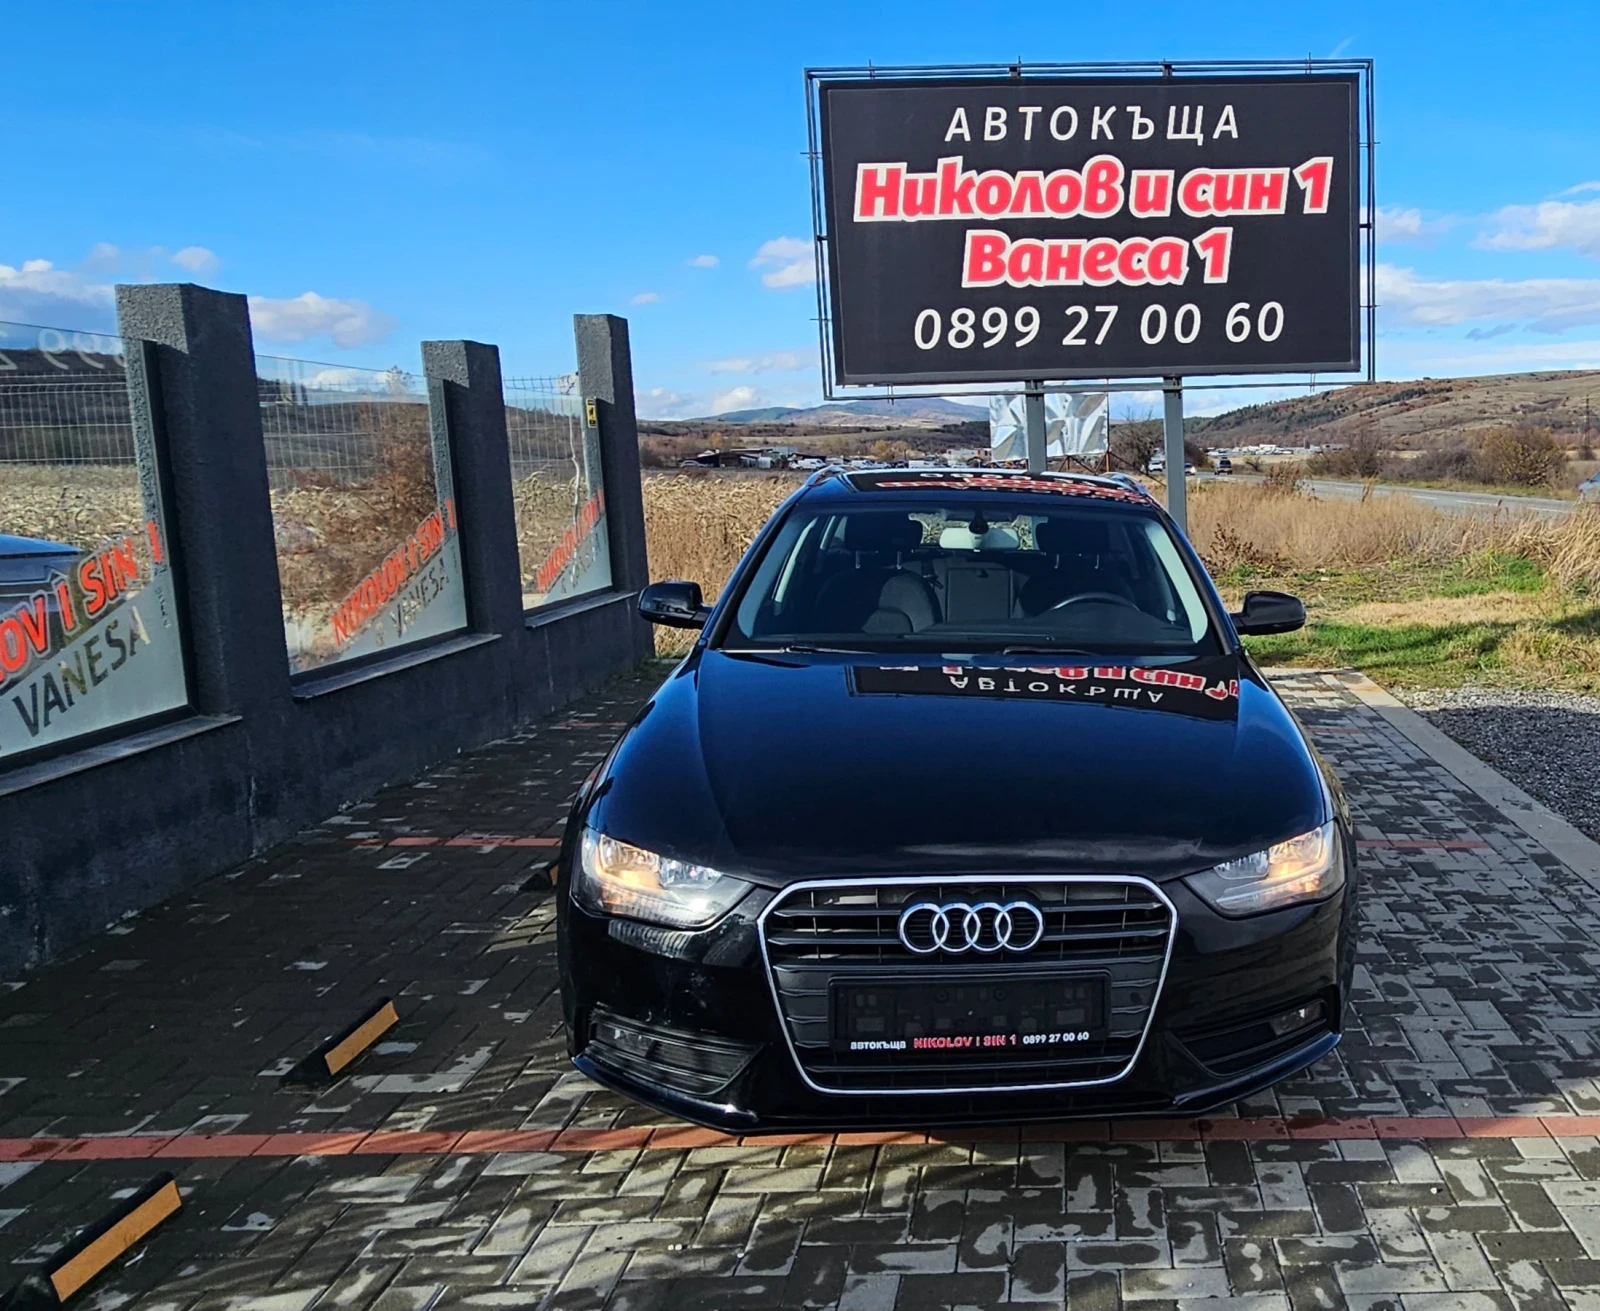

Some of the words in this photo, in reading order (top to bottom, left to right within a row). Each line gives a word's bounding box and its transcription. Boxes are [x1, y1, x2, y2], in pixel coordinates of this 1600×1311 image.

[944, 105, 1239, 145] АВТОКЪЩА
[853, 154, 1124, 222] Николов
[1129, 169, 1174, 218] и
[1178, 167, 1290, 217] син
[1293, 156, 1334, 214] 1
[961, 229, 1190, 288] Ванеса
[1193, 226, 1233, 284] 1
[914, 304, 1041, 350] 0899
[1061, 304, 1119, 346] 27
[1139, 303, 1202, 345] 00
[1225, 301, 1285, 343] 60
[331, 547, 406, 647] NIKOLOV
[418, 510, 444, 560] SIN
[0, 597, 47, 686] OV
[80, 538, 139, 614] SIN
[11, 605, 151, 738] VANESA
[850, 1040, 907, 1051] автокъща
[913, 1036, 973, 1049] NIKOLOV
[983, 1034, 1006, 1047] SIN
[1009, 1033, 1017, 1046] 1
[1022, 1034, 1047, 1045] 0899
[1048, 1032, 1061, 1043] 27
[1062, 1031, 1075, 1042] 00
[1077, 1030, 1090, 1041] 60
